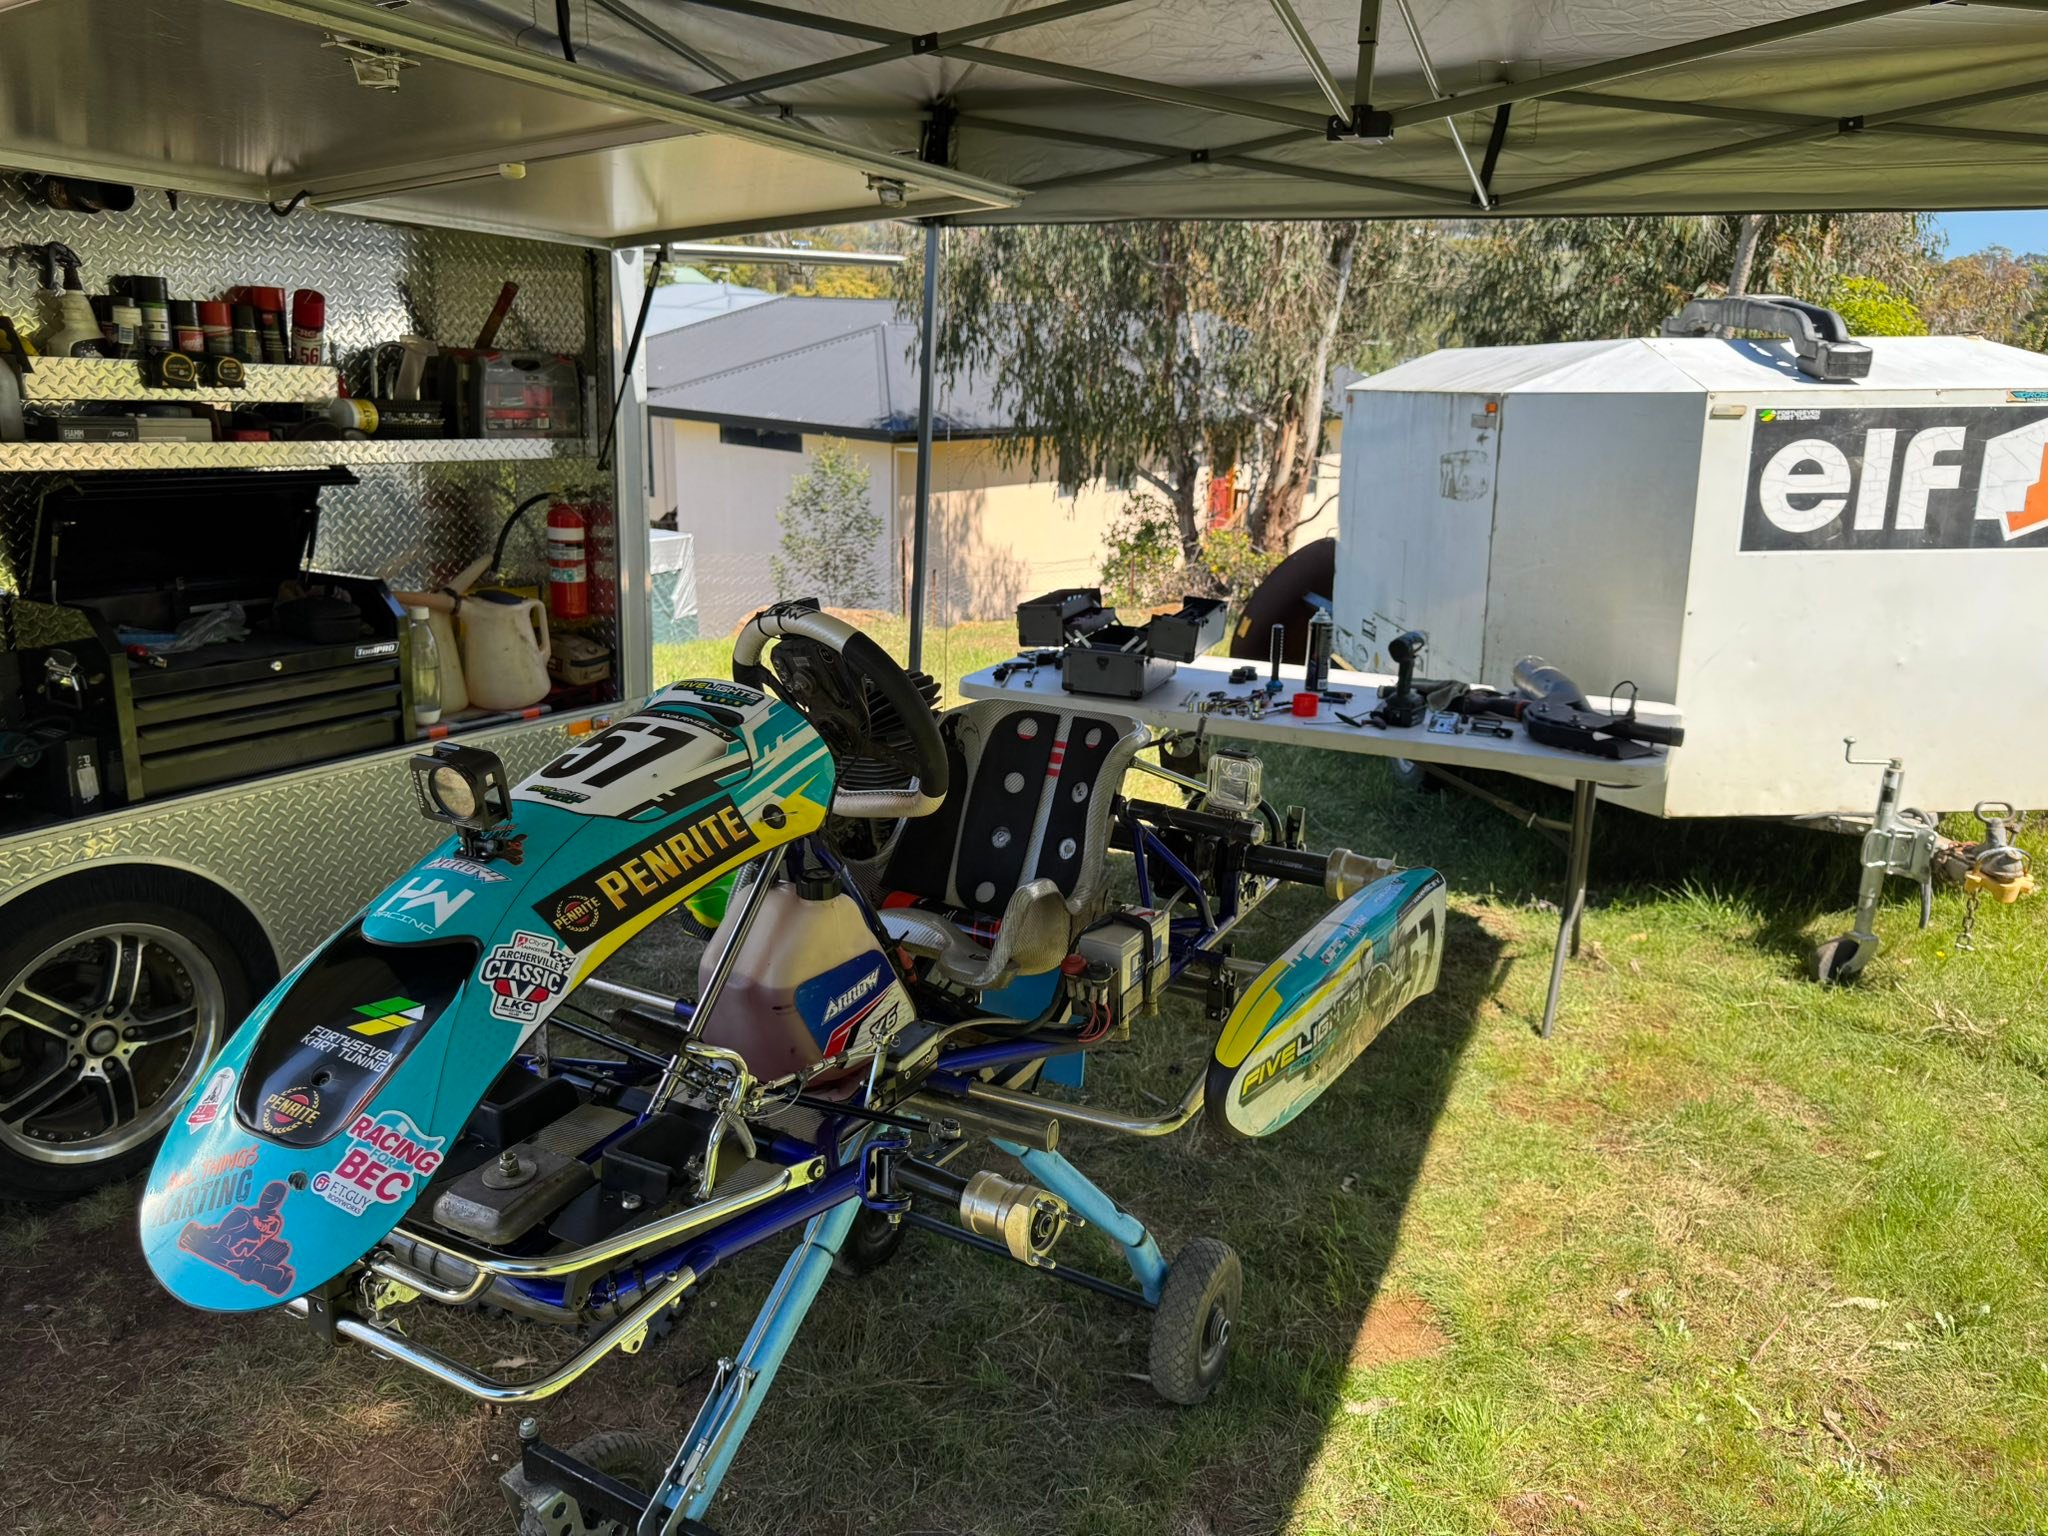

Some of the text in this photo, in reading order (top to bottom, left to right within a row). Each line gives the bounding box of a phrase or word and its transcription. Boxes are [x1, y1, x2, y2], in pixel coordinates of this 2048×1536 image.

[1759, 426, 1966, 533] elf
[540, 721, 699, 788] 57
[594, 805, 749, 911] PENRITE
[371, 911, 436, 935] RACING
[553, 896, 601, 930] PENRITE
[528, 938, 541, 947] City
[485, 960, 560, 992] CLASSIC
[500, 950, 560, 971] ARCHERVILLE
[501, 998, 533, 1011] LKC
[300, 1033, 387, 1073] KART TUNING
[310, 1024, 398, 1063] FORTYSEVEN
[263, 1094, 320, 1124] PENRITE
[202, 1144, 260, 1180] THINGS
[349, 1116, 440, 1174] RACING
[369, 1149, 396, 1168] FOR
[335, 1148, 411, 1201] BEC
[326, 1192, 361, 1215] BODYWORKS
